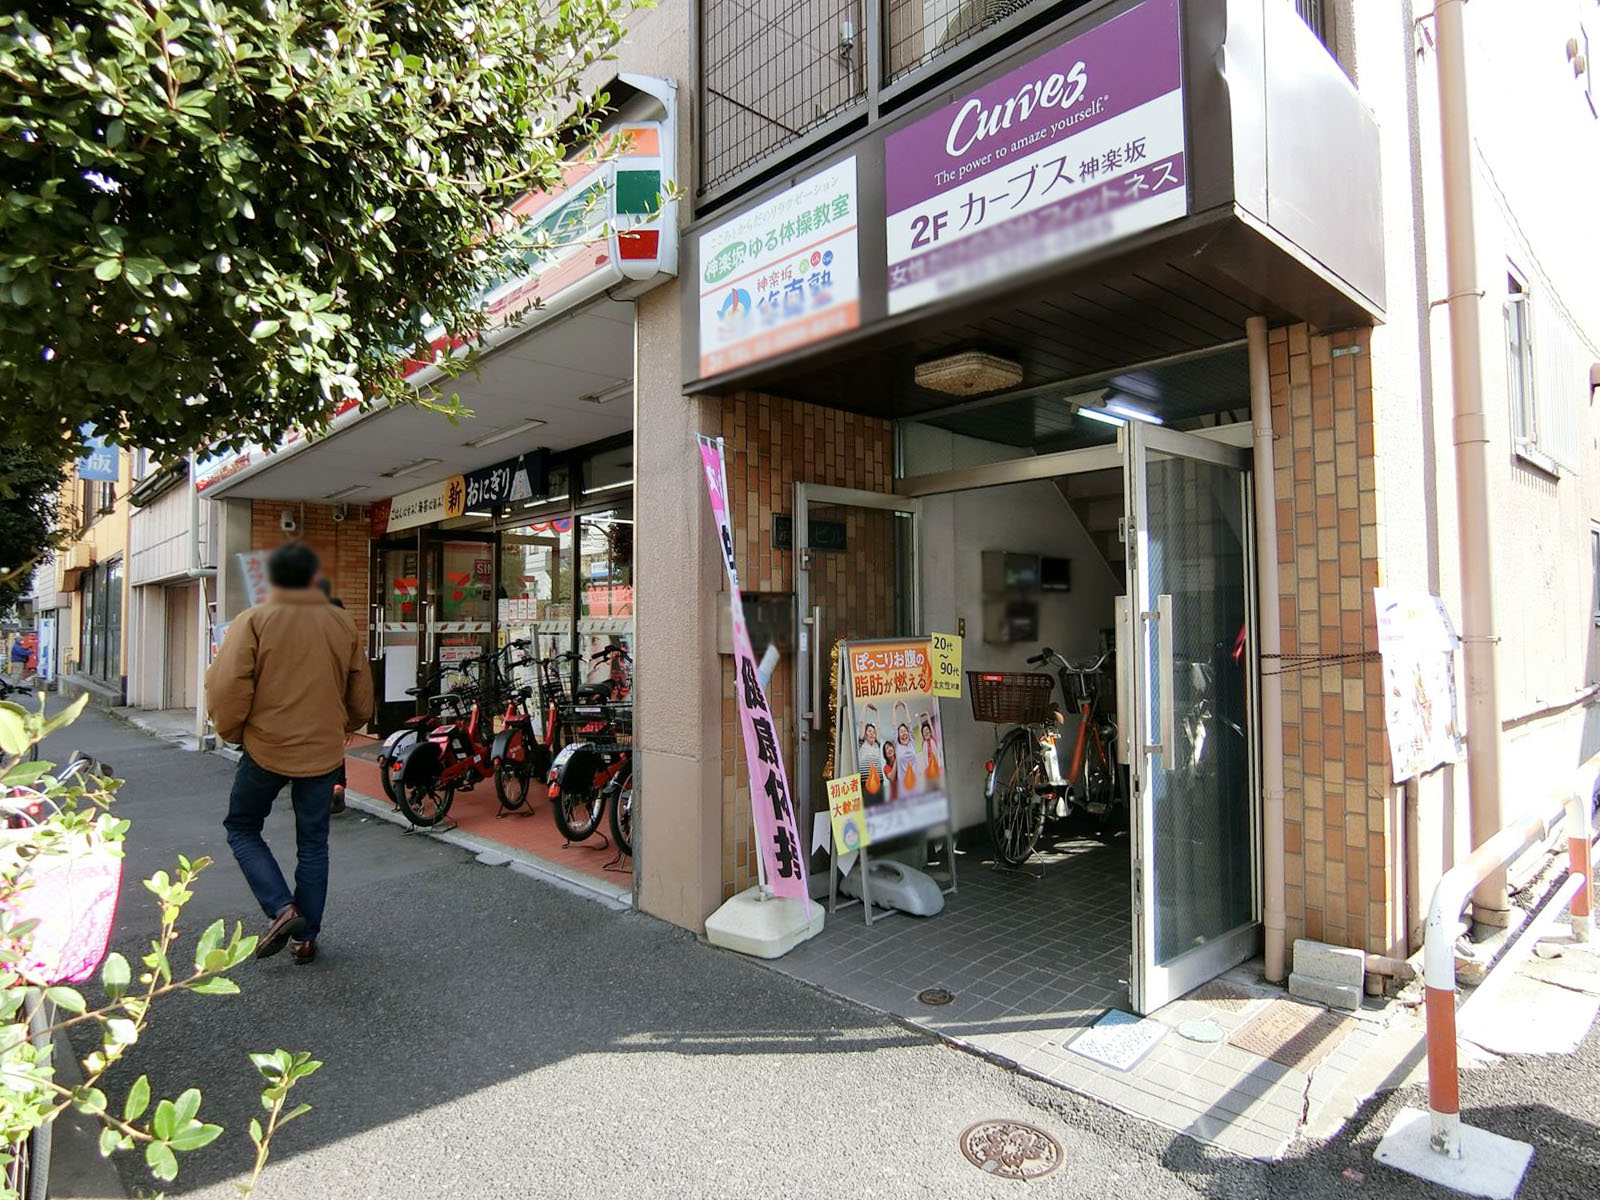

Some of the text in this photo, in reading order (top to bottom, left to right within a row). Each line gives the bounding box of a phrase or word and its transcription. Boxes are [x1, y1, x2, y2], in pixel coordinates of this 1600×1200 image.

[946, 61, 1088, 157] Curves
[934, 170, 956, 186] The
[958, 153, 992, 180] power
[996, 147, 1008, 159] to
[1010, 128, 1047, 152] amaze
[910, 137, 1146, 250] 2F カーブス 神楽坂
[757, 264, 793, 292] 神楽坂
[448, 480, 462, 513] 新
[466, 468, 510, 506] おにぎり
[934, 636, 953, 652] 20代
[855, 649, 925, 672] ぽっこりお腹の
[940, 662, 960, 677] 90代
[855, 671, 927, 698] 脂肪が燃える
[830, 778, 859, 798] 初心者
